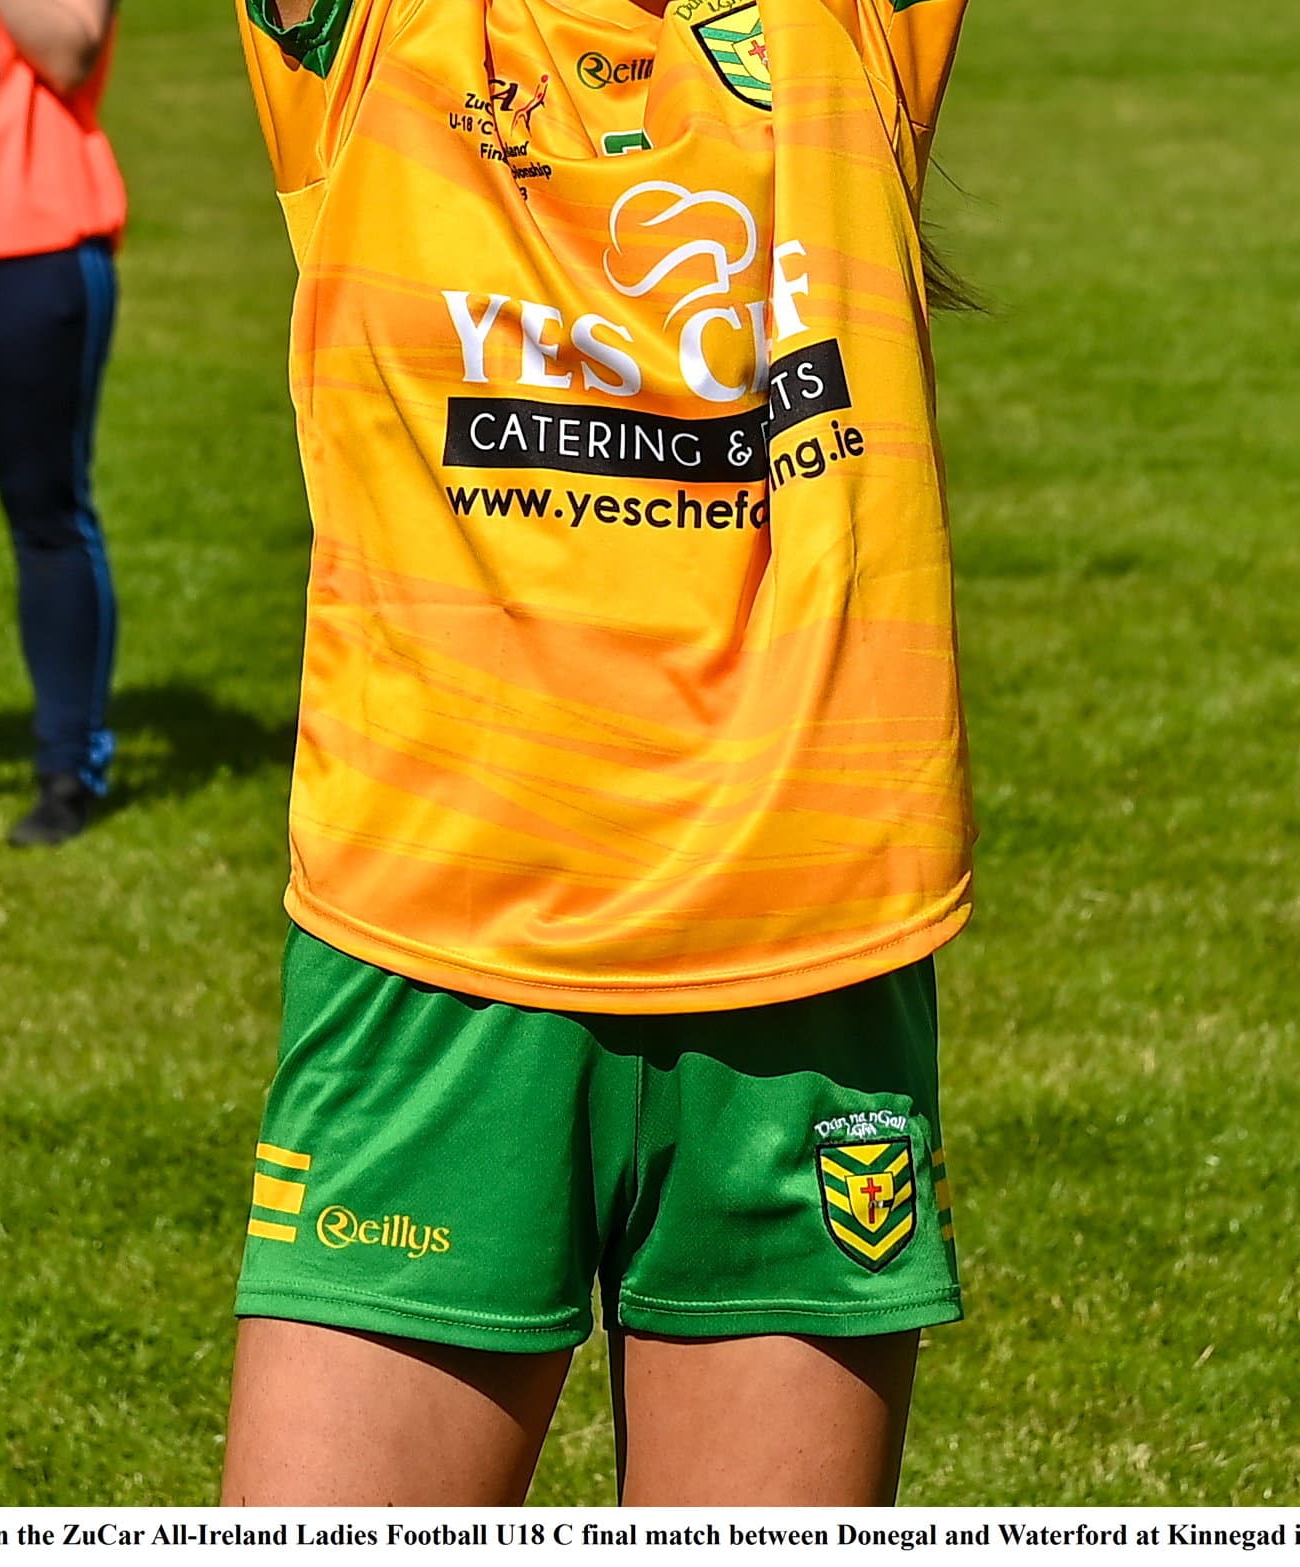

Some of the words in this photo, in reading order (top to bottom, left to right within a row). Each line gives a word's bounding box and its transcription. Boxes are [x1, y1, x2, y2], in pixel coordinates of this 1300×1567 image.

[576, 51, 656, 90] Reill
[465, 92, 494, 116] ZuC
[441, 290, 642, 397] YES
[469, 412, 701, 467] CATERING
[726, 430, 753, 466] &
[316, 1205, 451, 1259] Reillys
